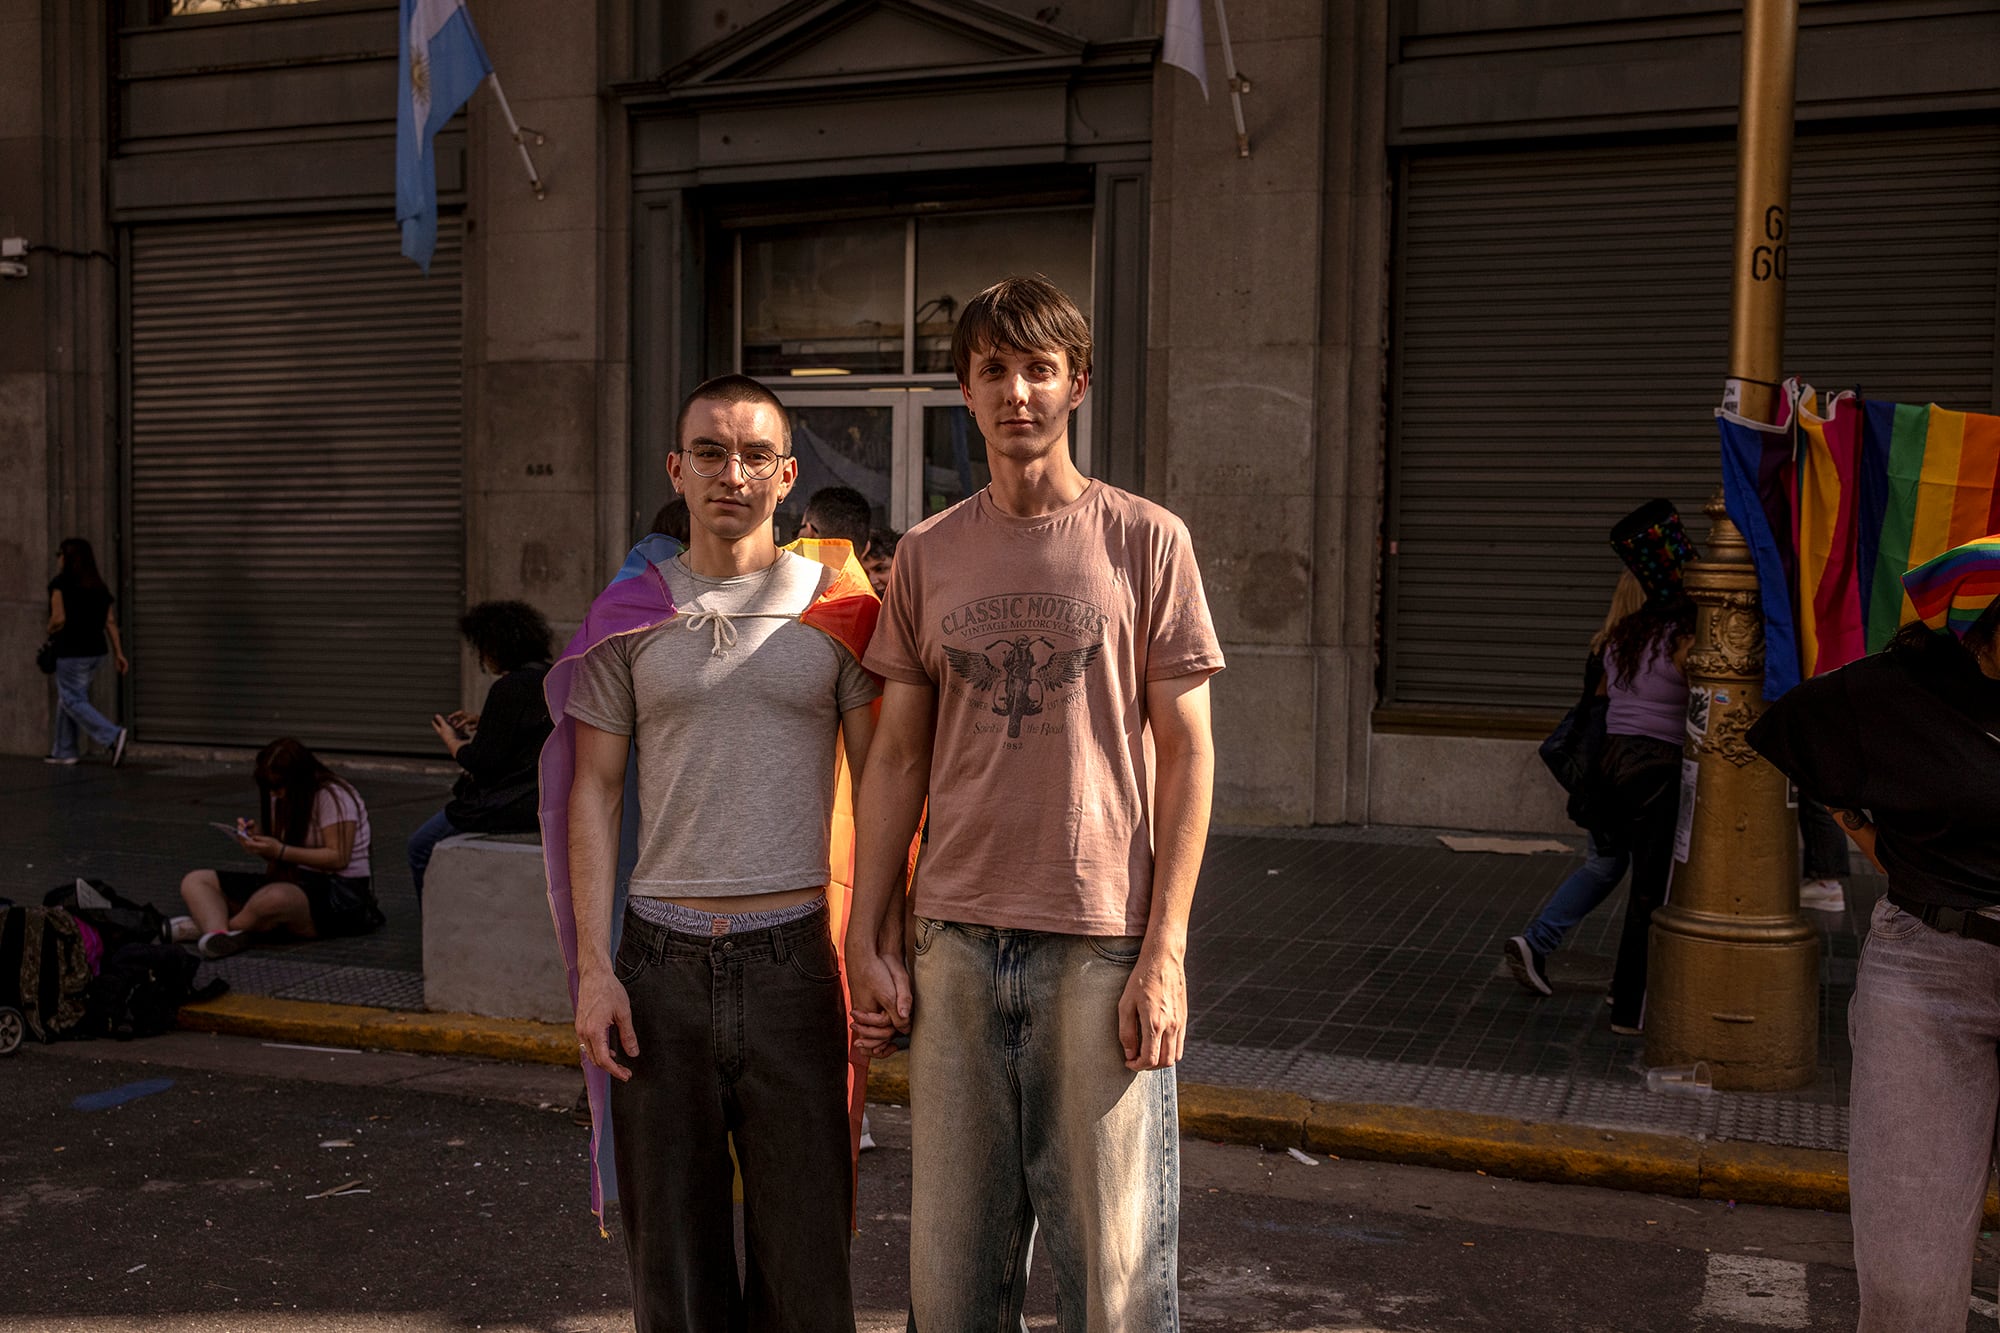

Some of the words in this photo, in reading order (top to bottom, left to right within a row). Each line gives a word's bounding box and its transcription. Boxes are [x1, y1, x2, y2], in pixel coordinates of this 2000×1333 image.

[941, 597, 1023, 636] CLASSIC
[1028, 596, 1110, 635] MOTORS
[961, 621, 1007, 638] VINTAGE
[1010, 619, 1083, 637] MOTORCYCLES
